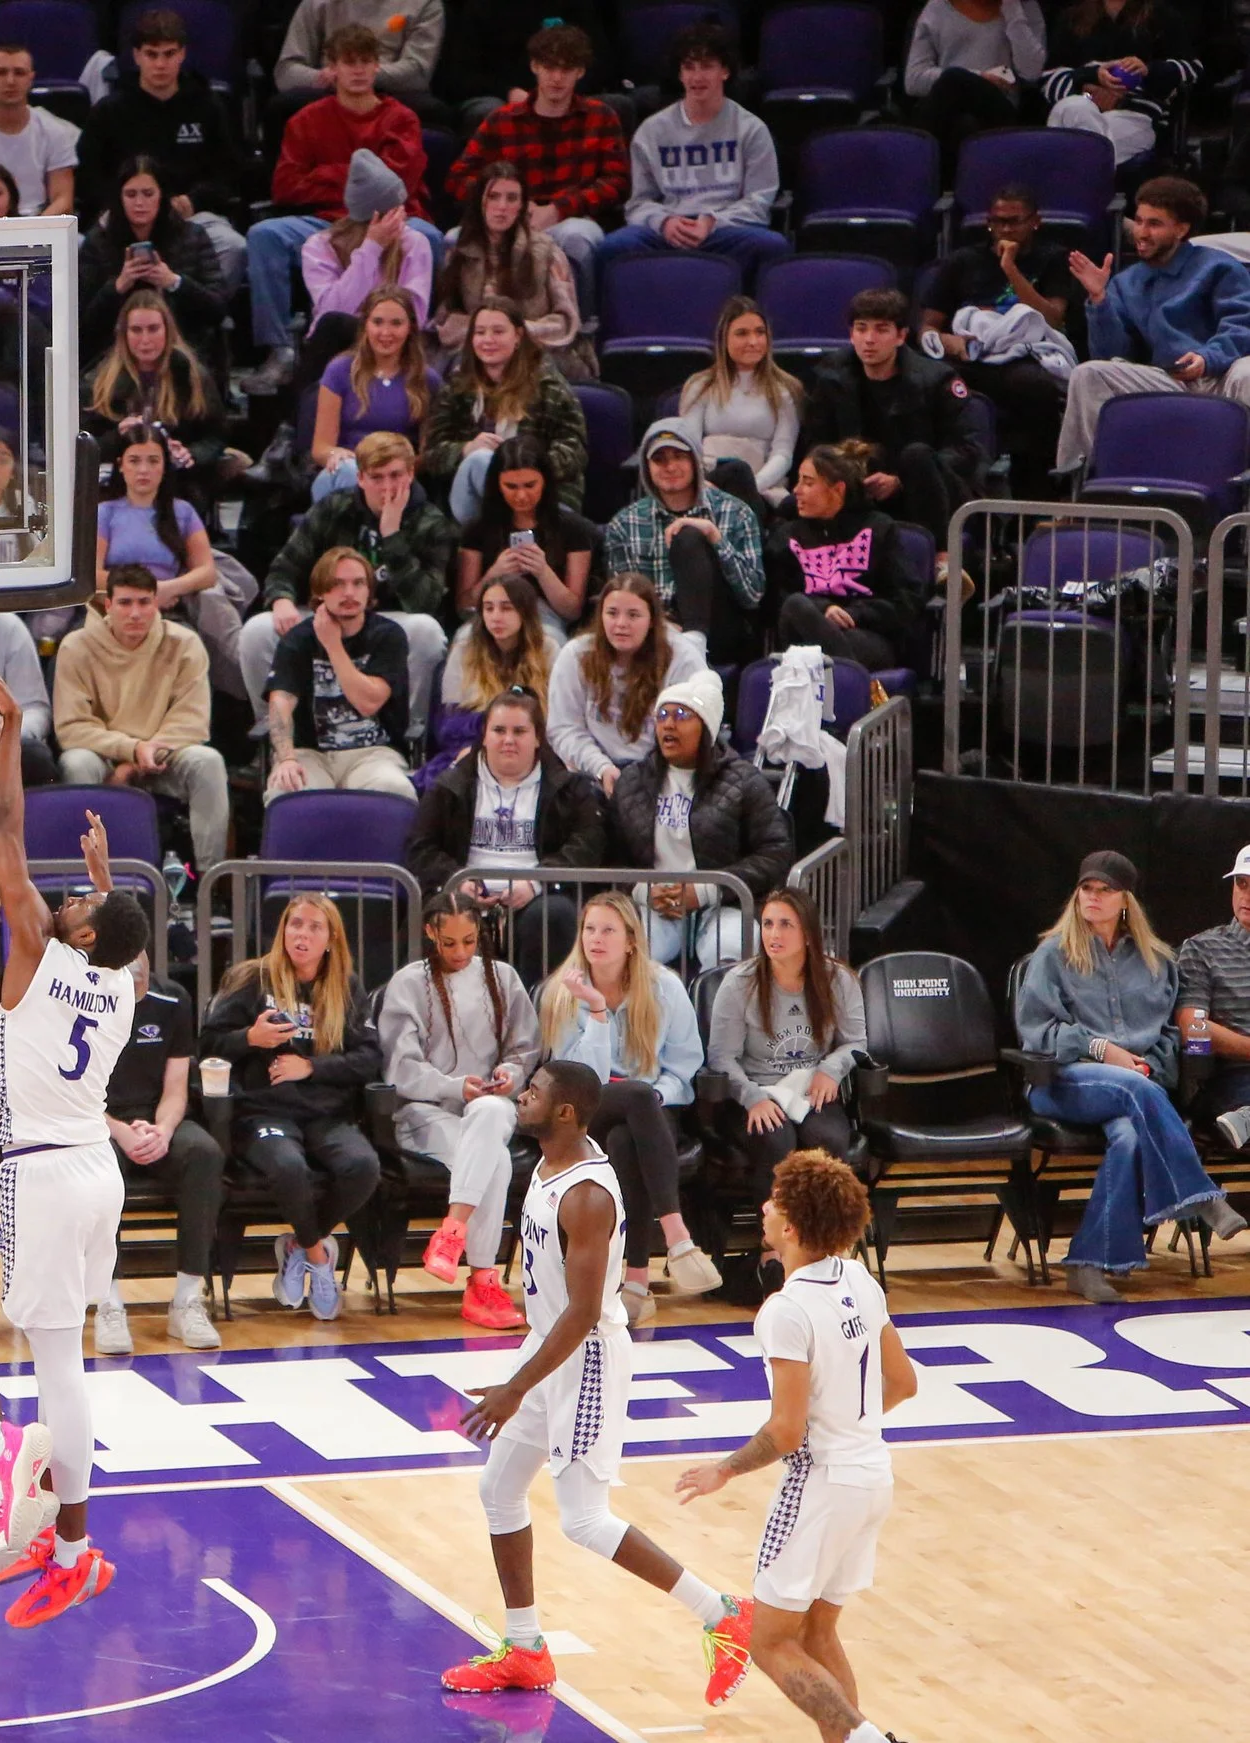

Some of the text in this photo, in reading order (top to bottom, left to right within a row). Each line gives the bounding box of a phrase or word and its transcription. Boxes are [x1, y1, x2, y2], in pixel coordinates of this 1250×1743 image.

[48, 978, 120, 1014] HAMILTON
[893, 978, 949, 989] HIGH POINT
[894, 987, 950, 997] UNIVERSITY
[58, 1014, 99, 1081] 5
[858, 1342, 870, 1421] 1
